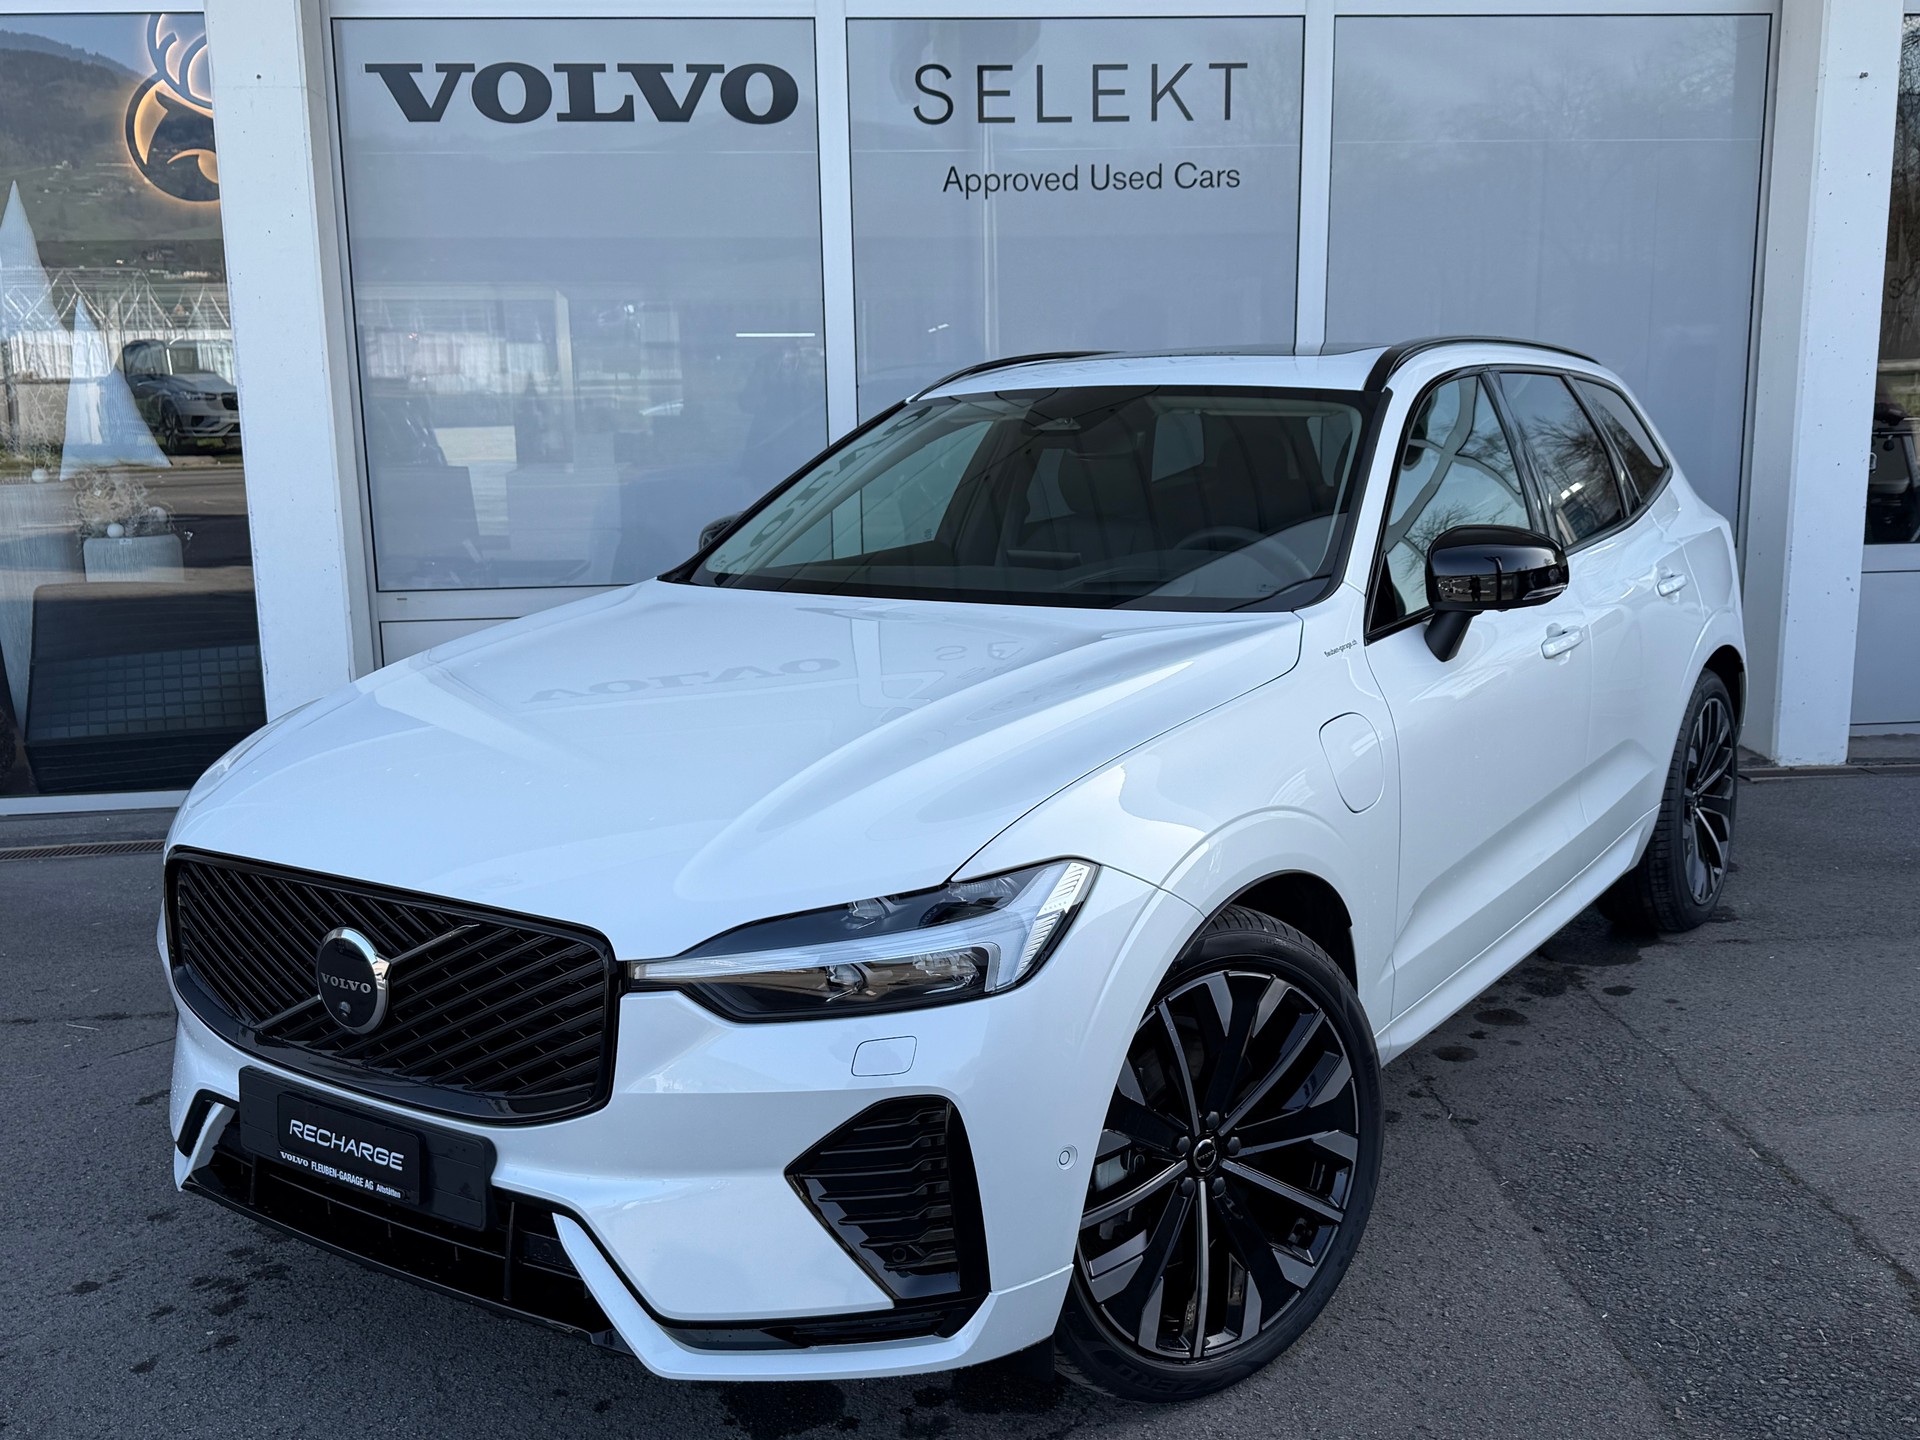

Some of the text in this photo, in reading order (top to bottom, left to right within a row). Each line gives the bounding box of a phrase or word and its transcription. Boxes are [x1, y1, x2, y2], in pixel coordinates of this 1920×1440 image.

[365, 62, 799, 124] VOLVO
[913, 62, 1248, 125] SELEKT
[942, 161, 1241, 201] Approved Used Cars
[320, 972, 372, 994] VOLVO
[289, 1119, 405, 1171] RECHARGE
[279, 1151, 309, 1168] VOLVO
[311, 1161, 364, 1187] FLEUBEN-GARAGE
[364, 1178, 374, 1191] AG
